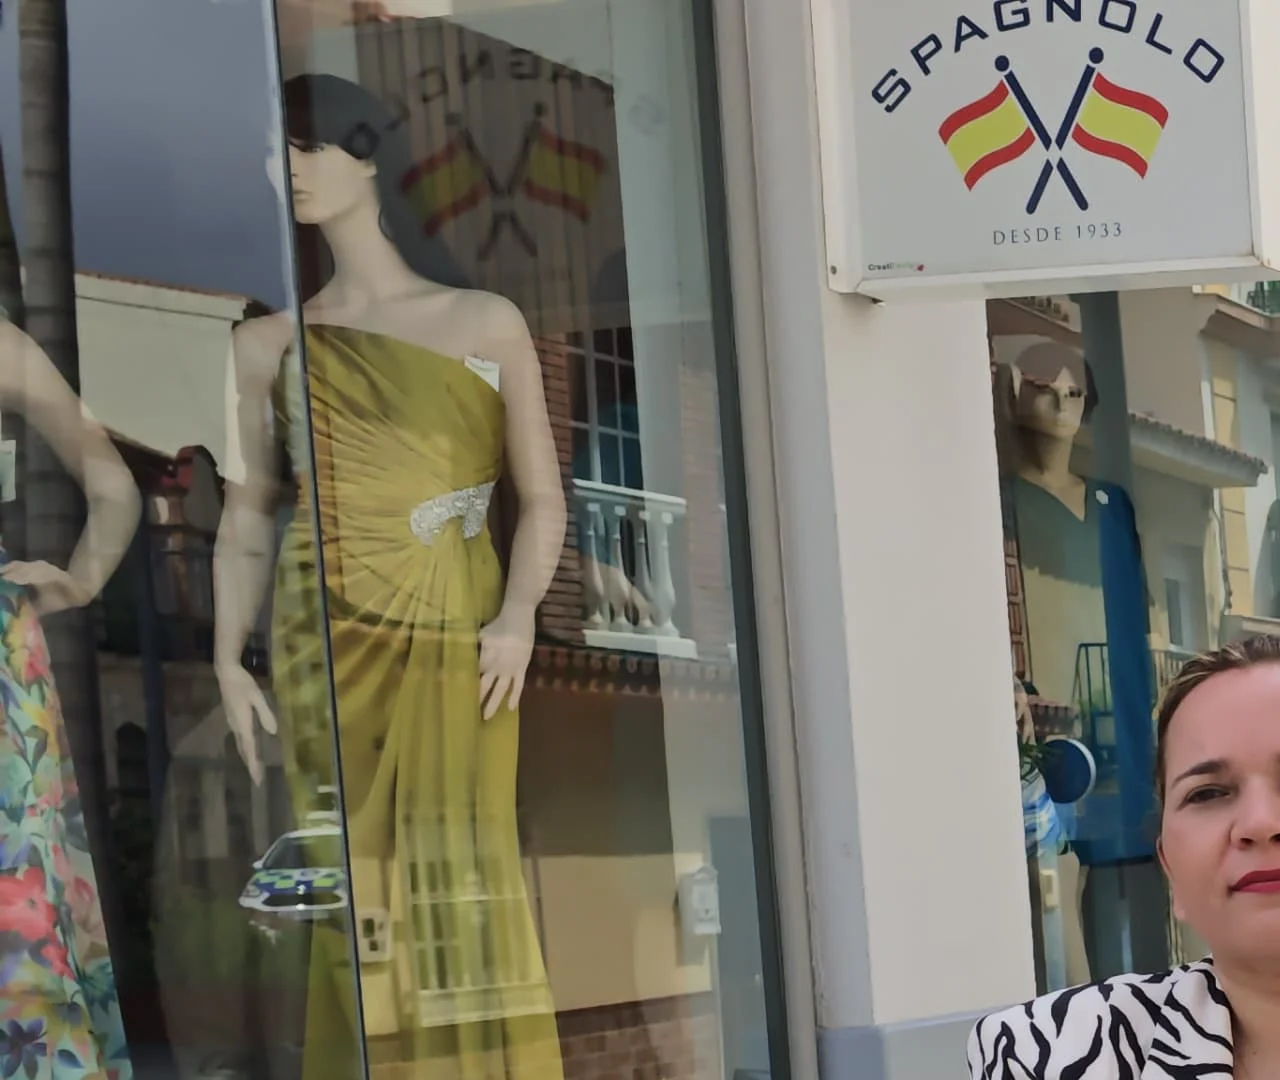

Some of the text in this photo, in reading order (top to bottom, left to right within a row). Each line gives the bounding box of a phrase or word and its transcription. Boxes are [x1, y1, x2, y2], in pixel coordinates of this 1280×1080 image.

[871, 0, 1225, 113] SPAGNOLO
[993, 222, 1122, 245] DESDE 1933
